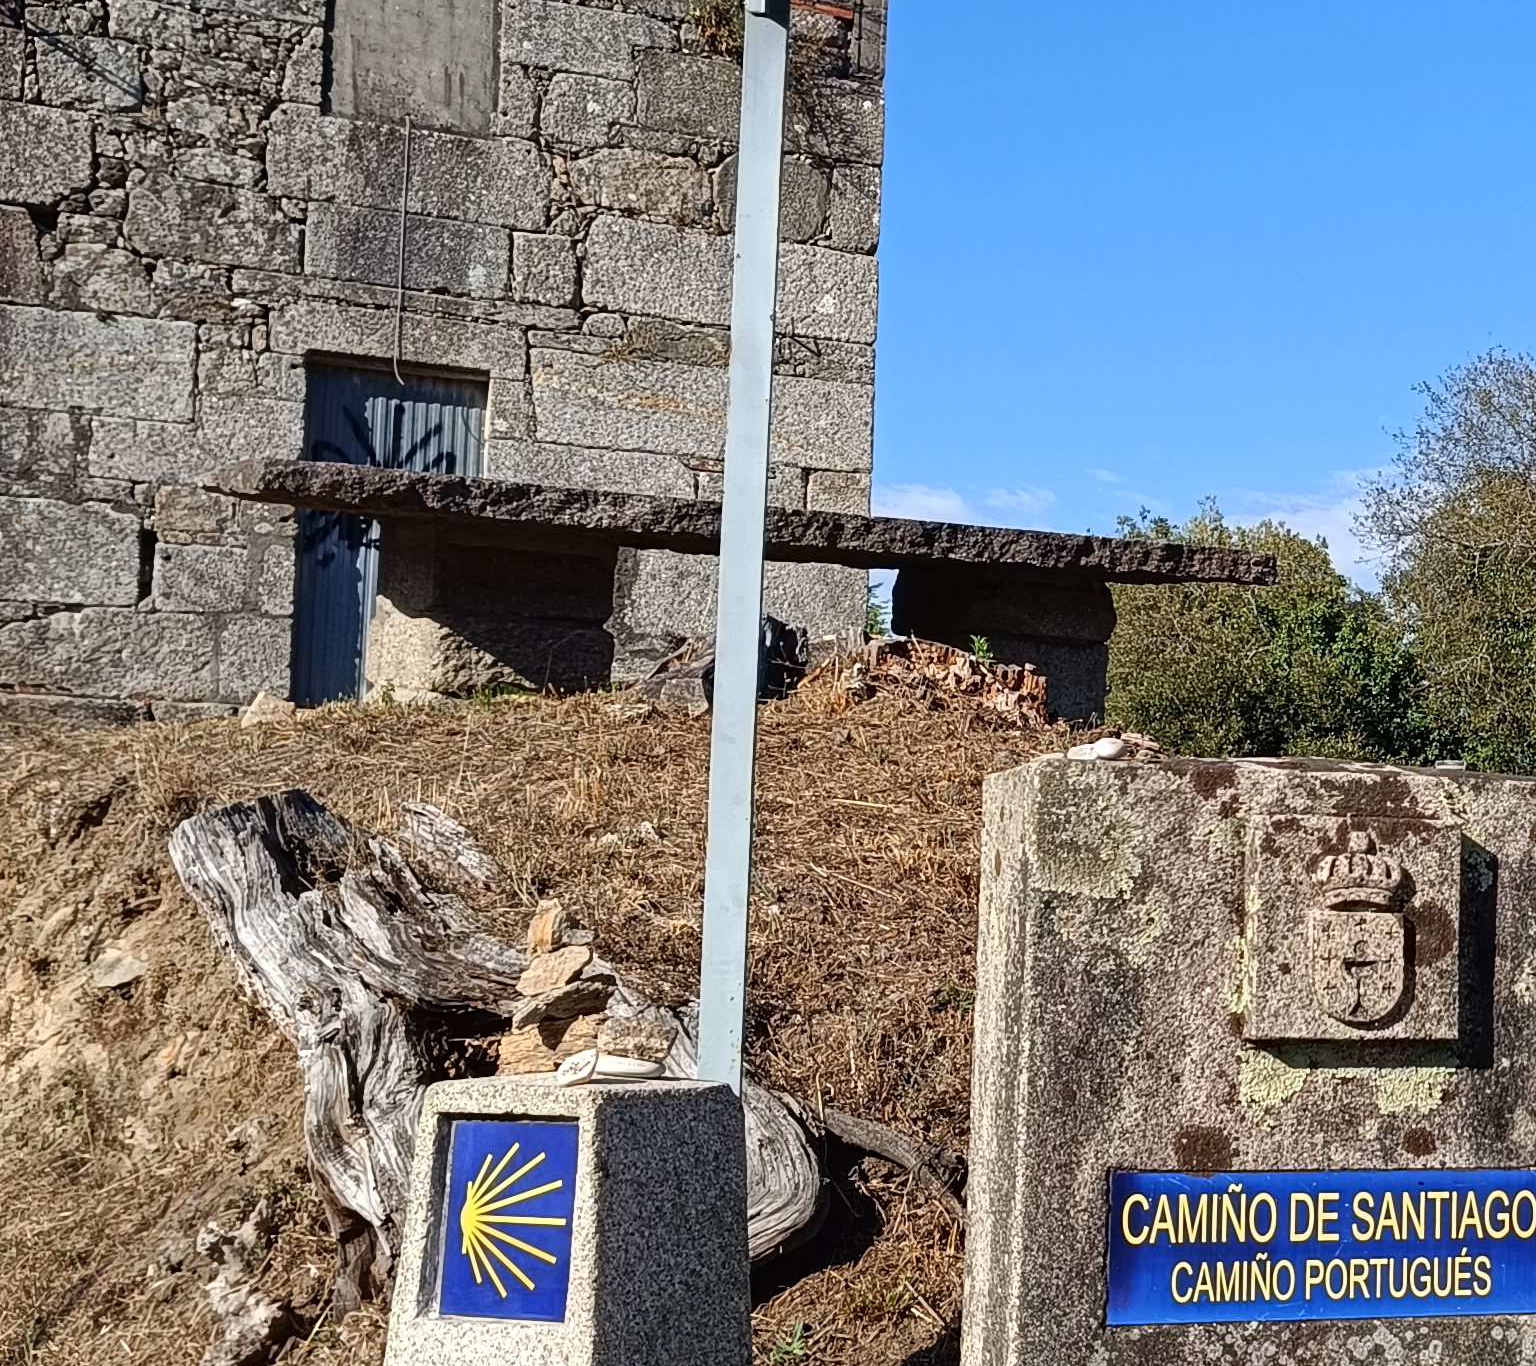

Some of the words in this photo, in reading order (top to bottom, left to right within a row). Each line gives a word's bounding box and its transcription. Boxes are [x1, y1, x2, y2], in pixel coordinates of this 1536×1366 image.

[1121, 1183, 1278, 1245] CAMIÑO
[1289, 1192, 1340, 1242] DE
[1171, 1253, 1296, 1304] CAMIÑO
[1305, 1247, 1493, 1300] PORTUGUÉS
